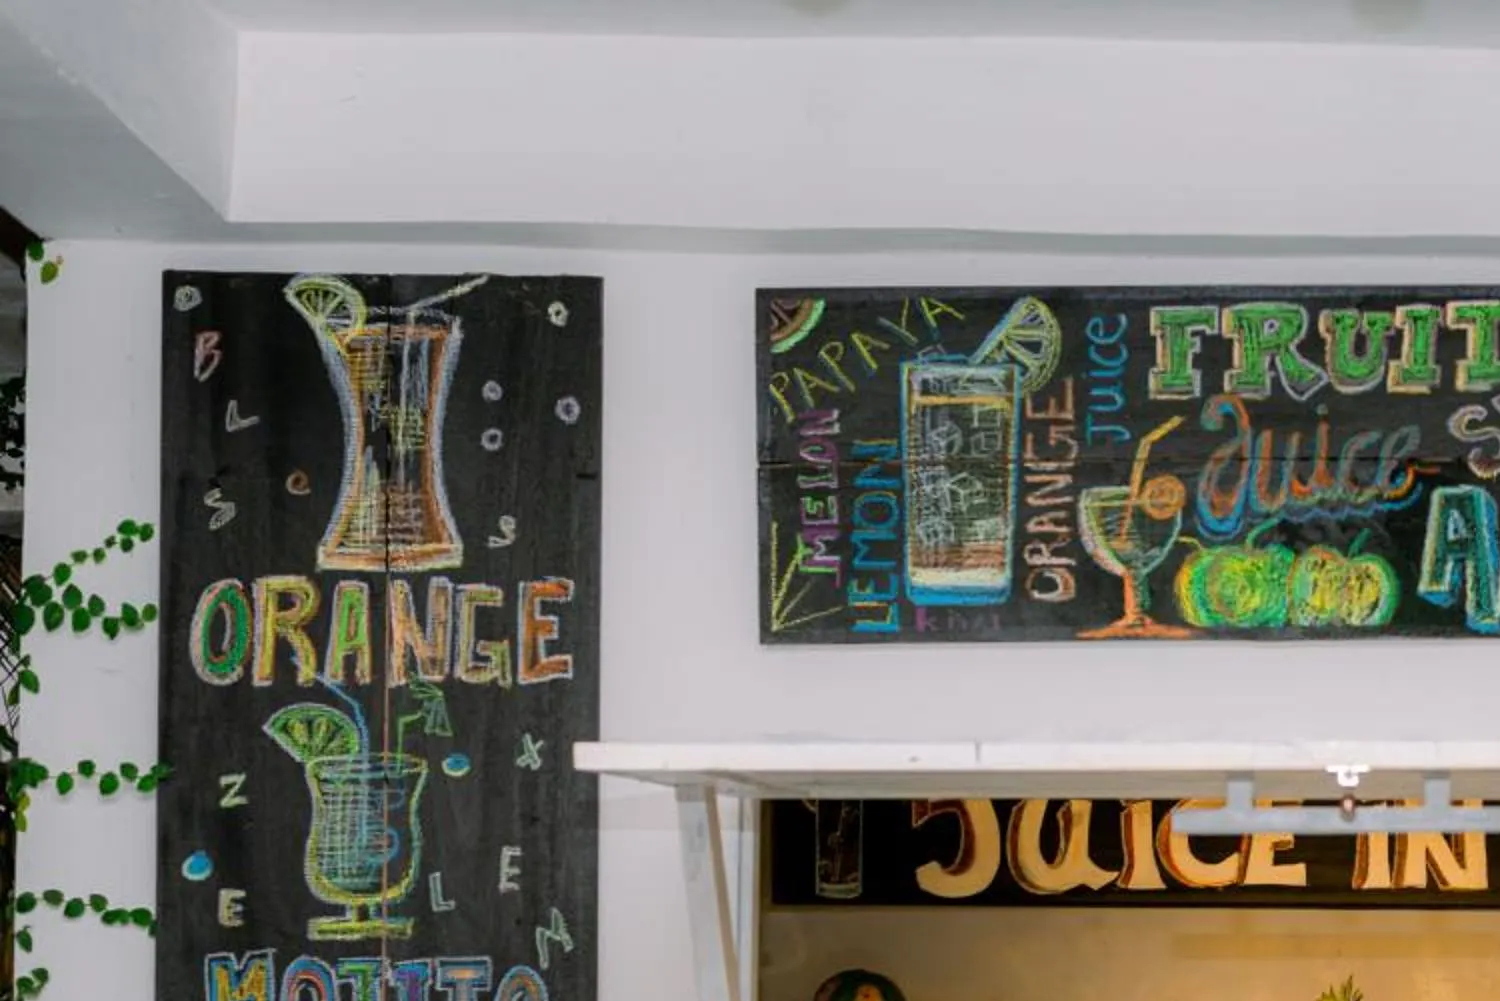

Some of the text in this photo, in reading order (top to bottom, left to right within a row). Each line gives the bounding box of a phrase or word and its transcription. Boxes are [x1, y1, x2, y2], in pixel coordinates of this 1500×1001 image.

[769, 297, 965, 423] PAPAYA
[799, 408, 841, 587] MELON
[848, 438, 900, 633] LEMON
[1023, 377, 1077, 602] ORANGE
[190, 575, 574, 687] ORANGE
